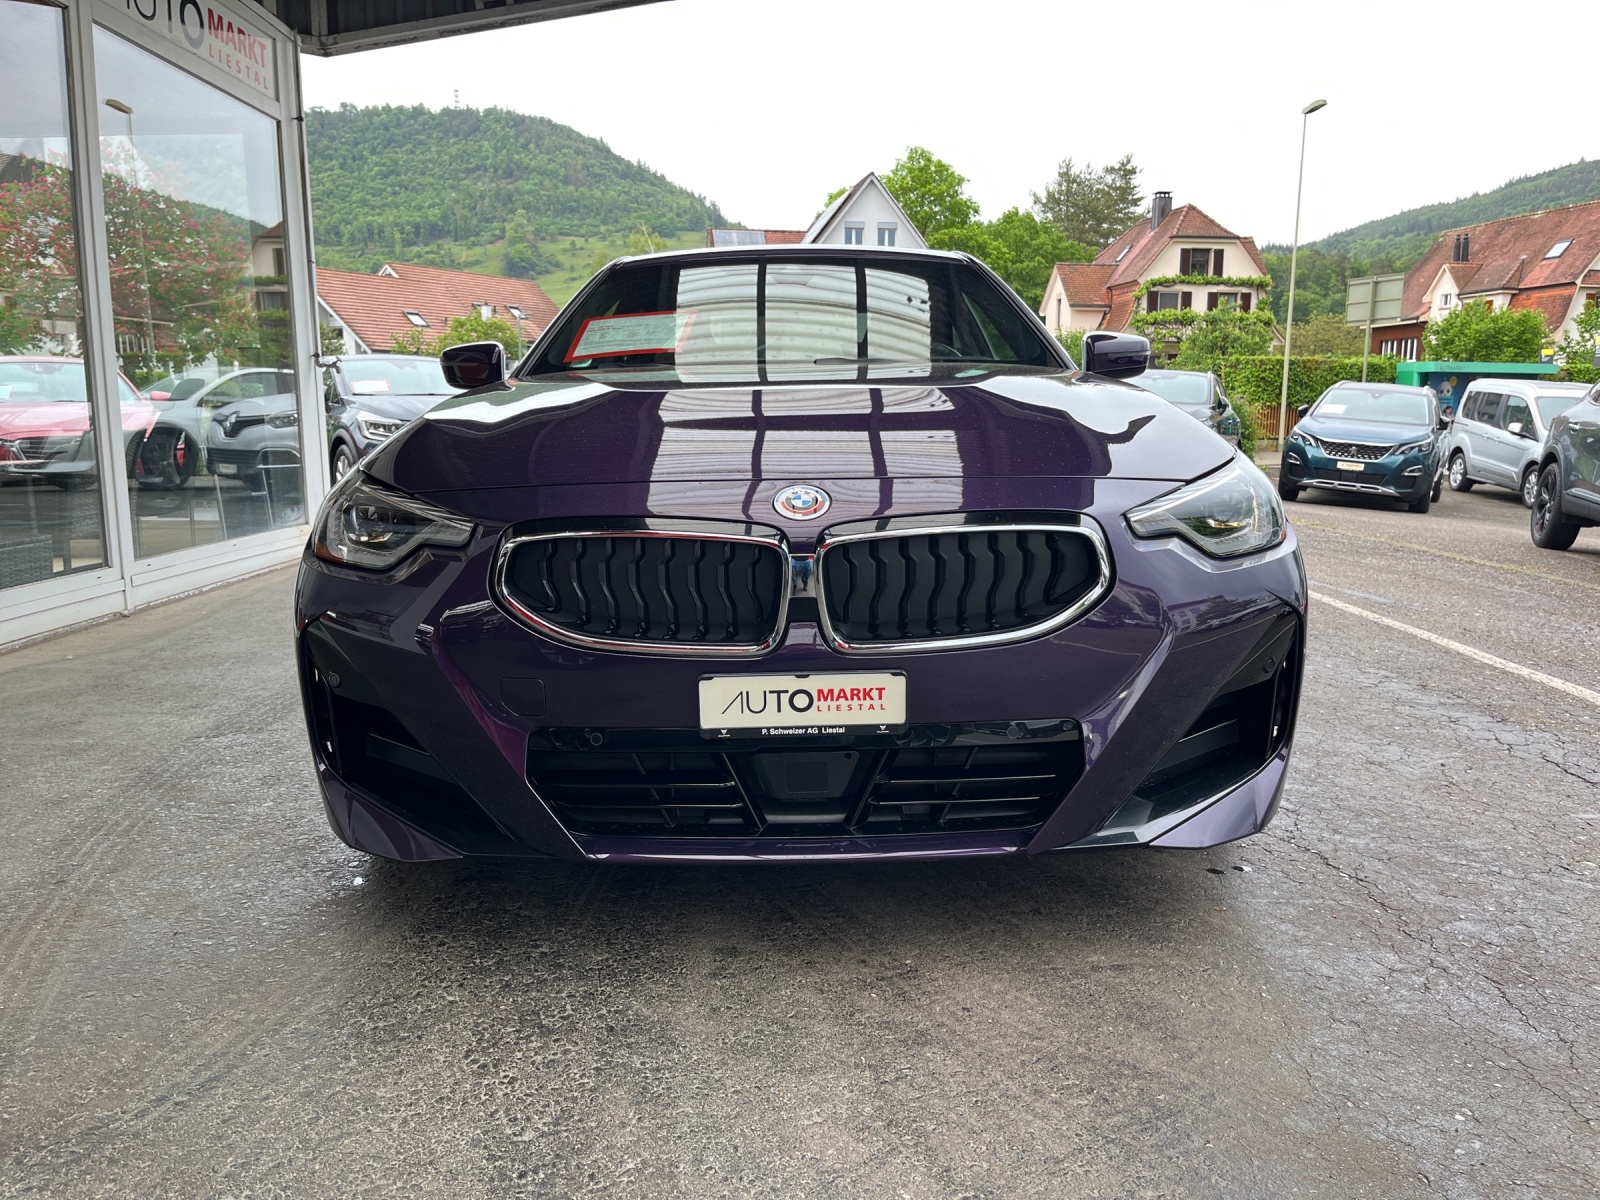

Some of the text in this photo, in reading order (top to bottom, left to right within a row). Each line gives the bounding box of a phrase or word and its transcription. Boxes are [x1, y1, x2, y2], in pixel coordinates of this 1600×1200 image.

[127, 0, 267, 68] TO MARKT
[208, 43, 269, 91] LIESTAL
[721, 687, 886, 715] AUTO MARKT
[816, 703, 886, 712] LIESTAL
[769, 727, 806, 735] Schweizer
[822, 726, 846, 734] Liestal
